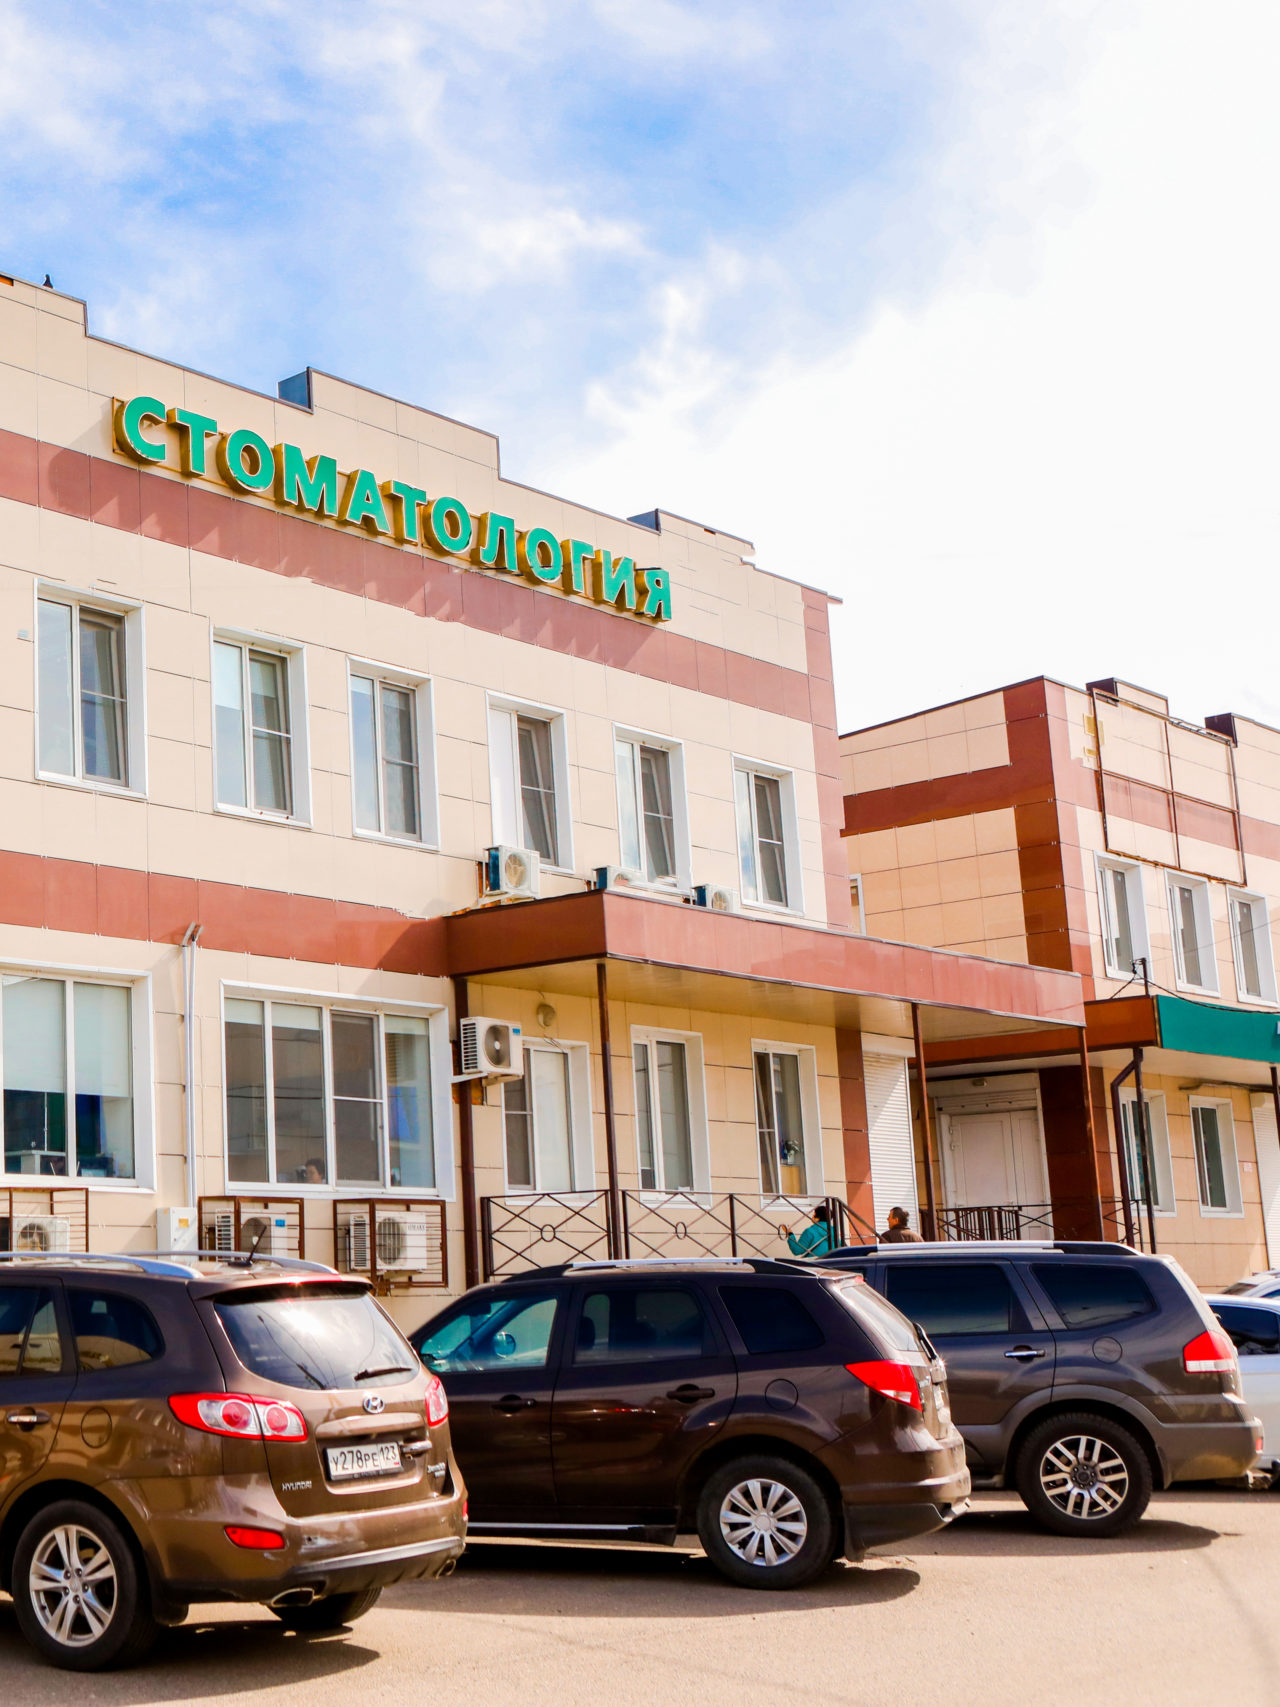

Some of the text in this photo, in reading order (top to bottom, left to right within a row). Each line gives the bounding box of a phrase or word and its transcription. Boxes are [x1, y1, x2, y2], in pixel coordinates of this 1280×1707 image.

[118, 396, 672, 621] СТОМАТОЛОГИЯ
[332, 1450, 379, 1472] У278РЕ
[282, 1480, 312, 1492] HYUNDAI
